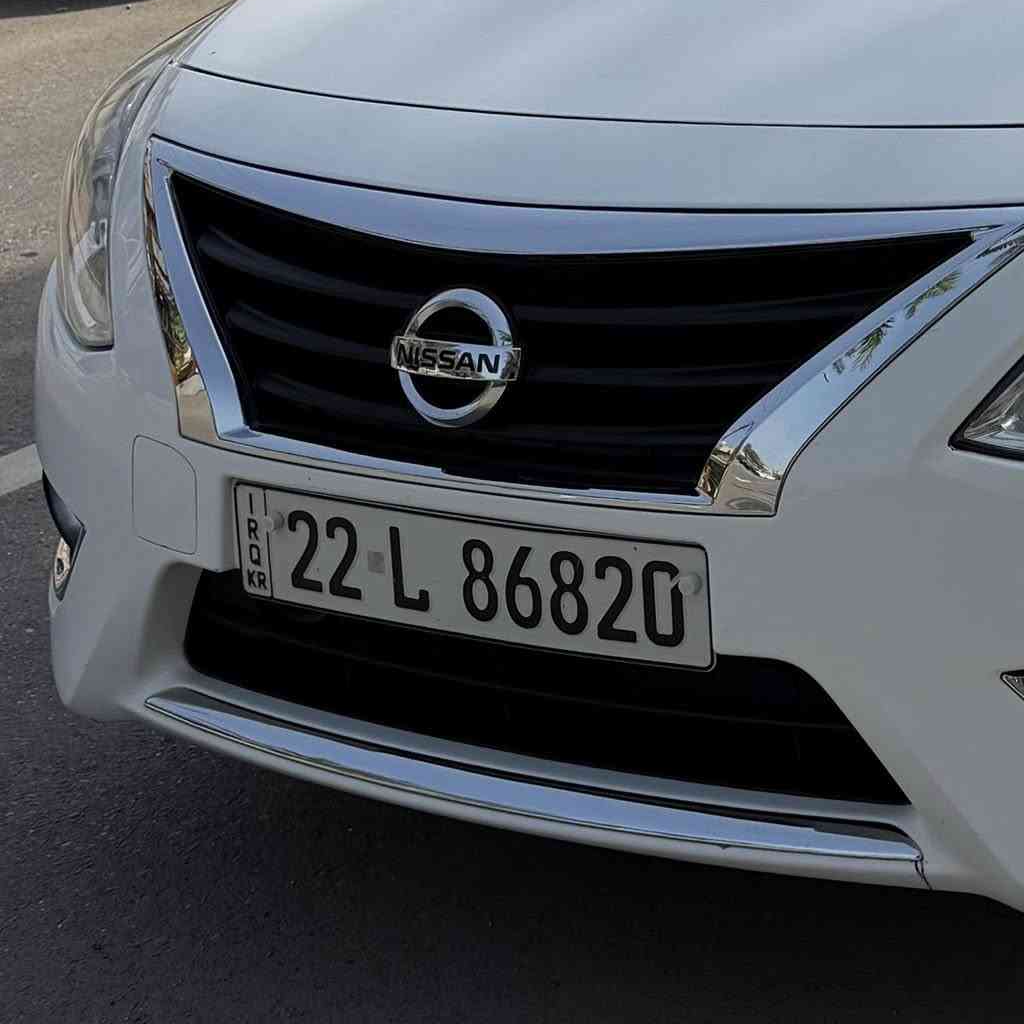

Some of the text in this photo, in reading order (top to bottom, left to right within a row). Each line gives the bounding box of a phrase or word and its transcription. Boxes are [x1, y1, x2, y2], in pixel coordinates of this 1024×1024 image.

[397, 343, 500, 374] NISSAN
[287, 509, 685, 647] 22 L 86820
